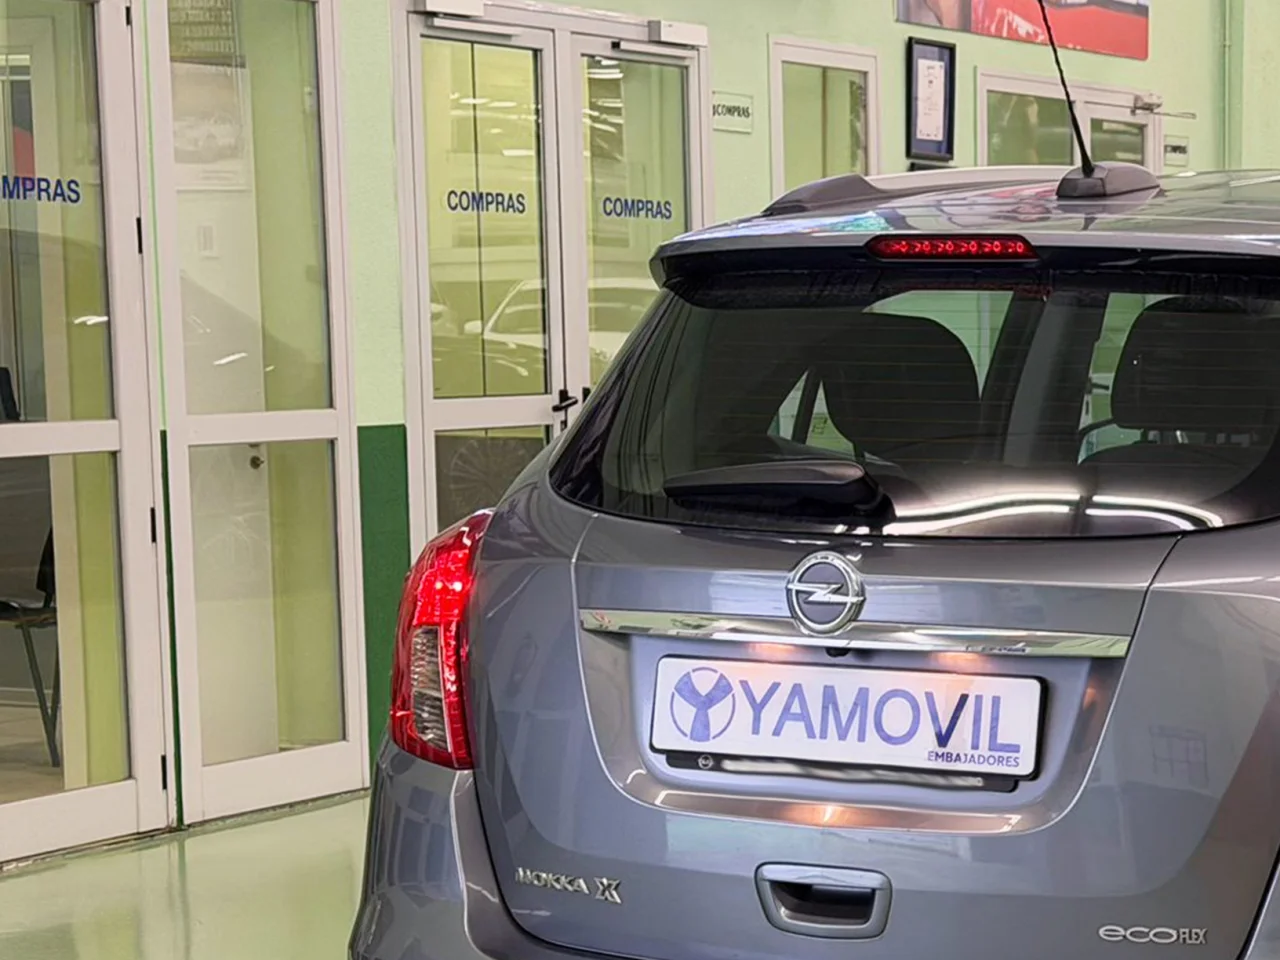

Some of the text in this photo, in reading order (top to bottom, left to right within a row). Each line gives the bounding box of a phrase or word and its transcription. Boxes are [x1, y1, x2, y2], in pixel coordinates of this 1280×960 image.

[447, 190, 526, 214] COMPRAS
[602, 197, 672, 220] COMPRAS
[738, 678, 1021, 754] YAMOVIL
[927, 750, 1021, 768] EMBAJADORES
[515, 866, 622, 904] MOKKA X
